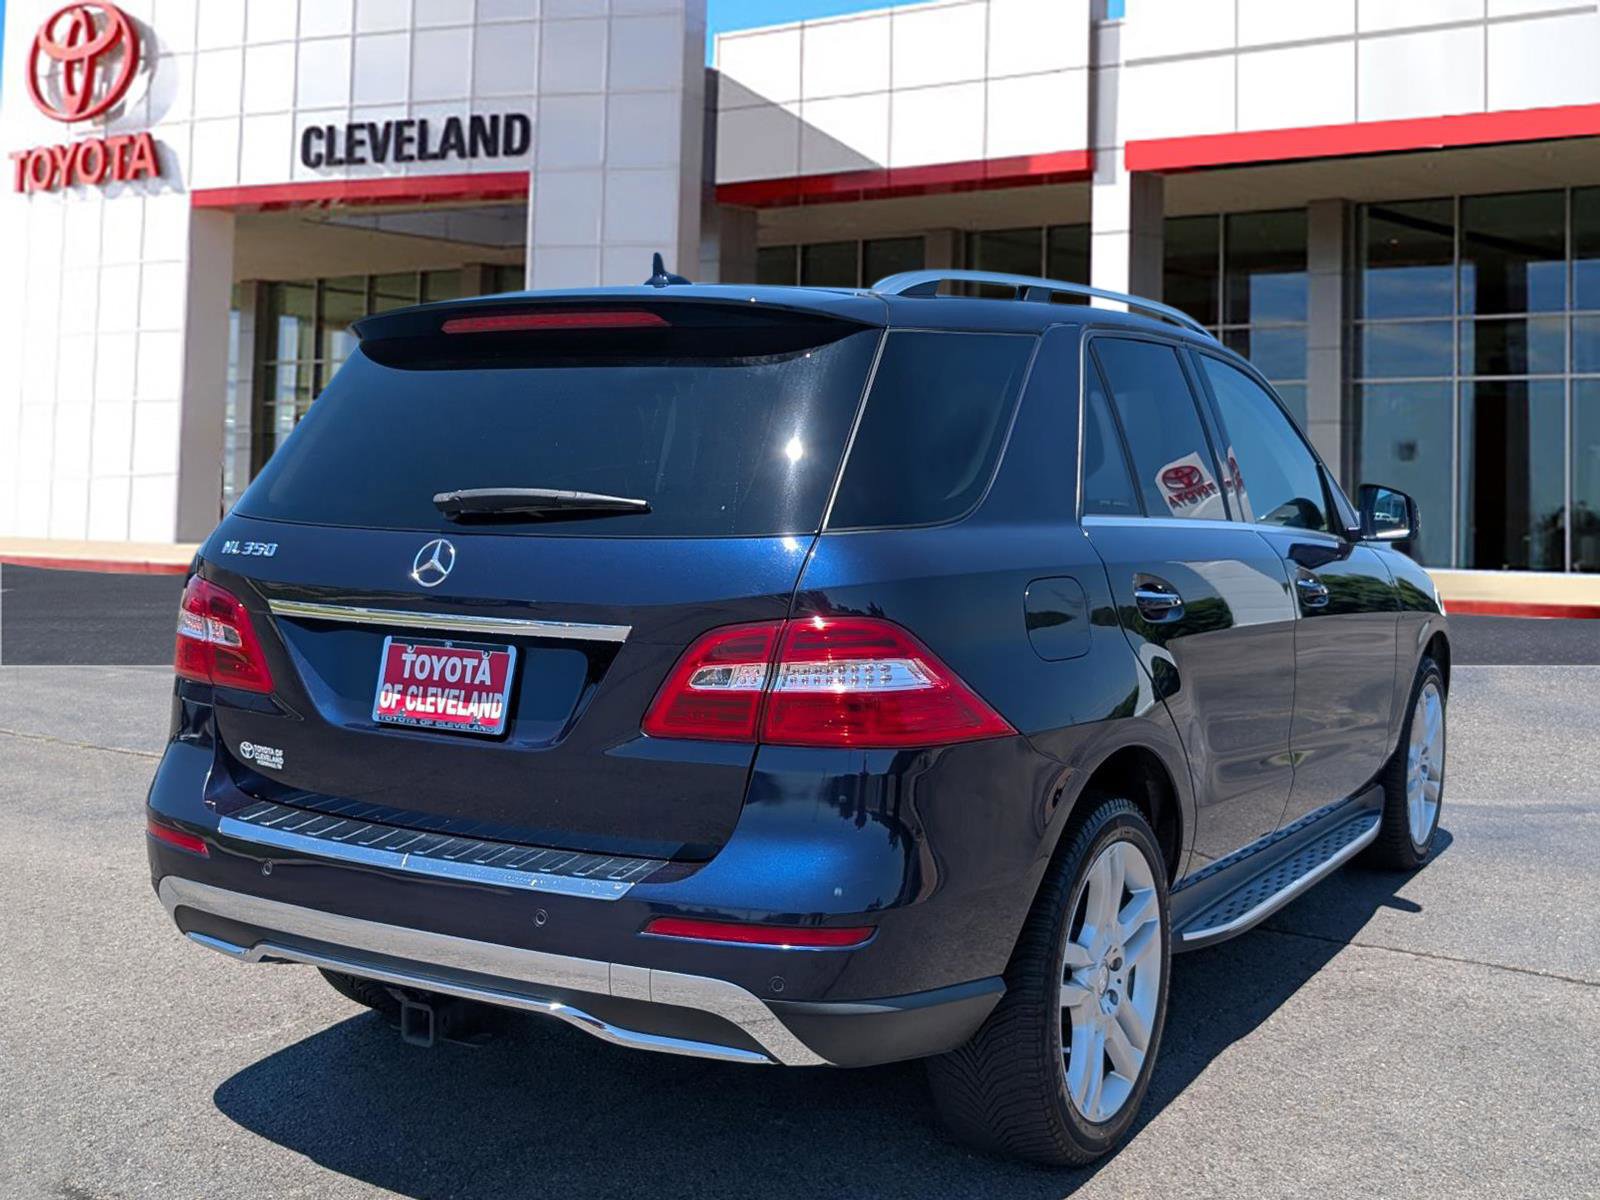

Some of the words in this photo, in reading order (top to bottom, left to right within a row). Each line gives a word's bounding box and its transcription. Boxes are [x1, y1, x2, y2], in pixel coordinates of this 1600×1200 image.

[301, 113, 531, 168] CLEVELAND
[9, 132, 160, 193] TOYOTA
[402, 652, 491, 685] TOYOTA
[380, 683, 403, 709] OF
[405, 685, 503, 719] CLEVELAND
[380, 714, 417, 725] TOYOTA
